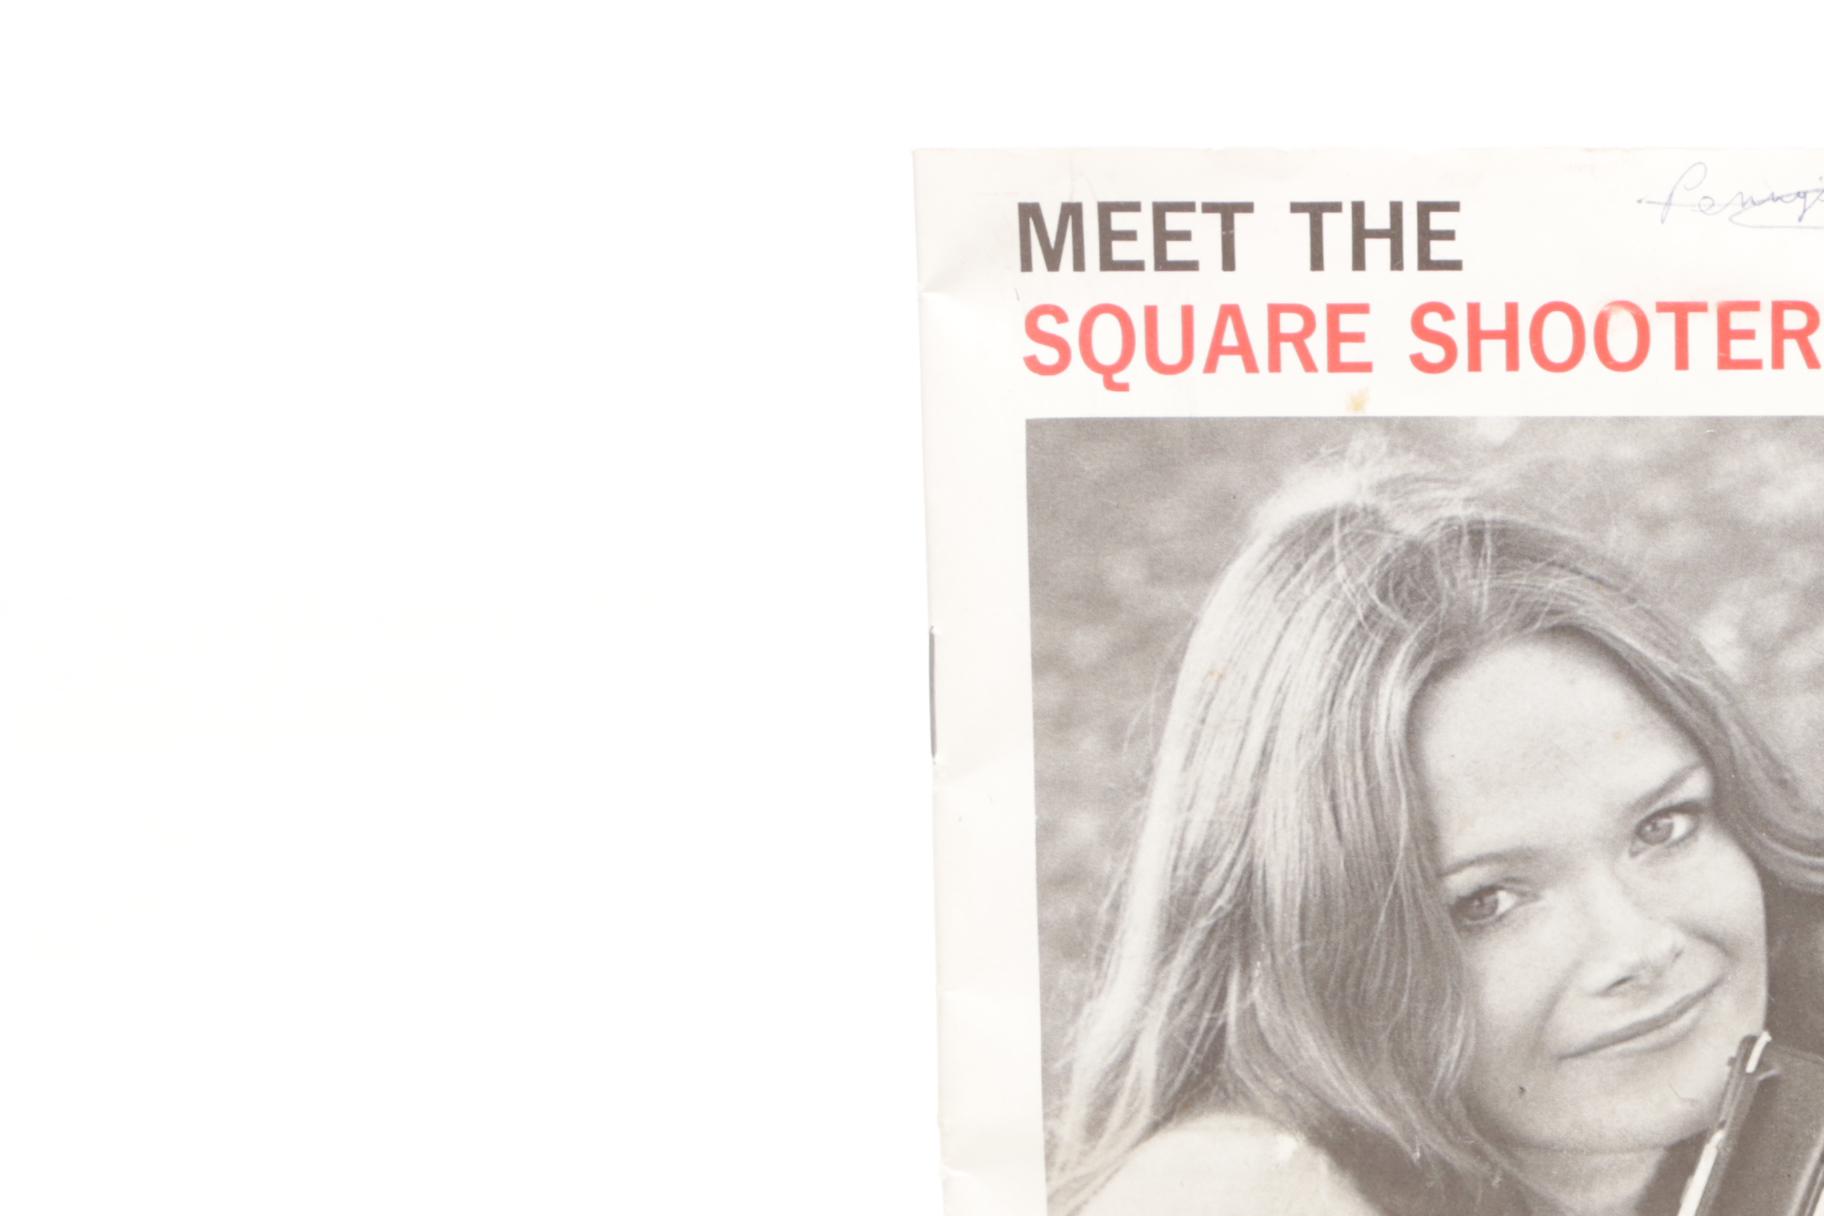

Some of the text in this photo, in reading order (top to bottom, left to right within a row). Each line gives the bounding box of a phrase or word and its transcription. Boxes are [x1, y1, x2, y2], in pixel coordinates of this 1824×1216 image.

[1017, 200, 1463, 273] MEET THE
[1023, 303, 1373, 393] SQUARE
[1409, 300, 1822, 375] SHOOTER
